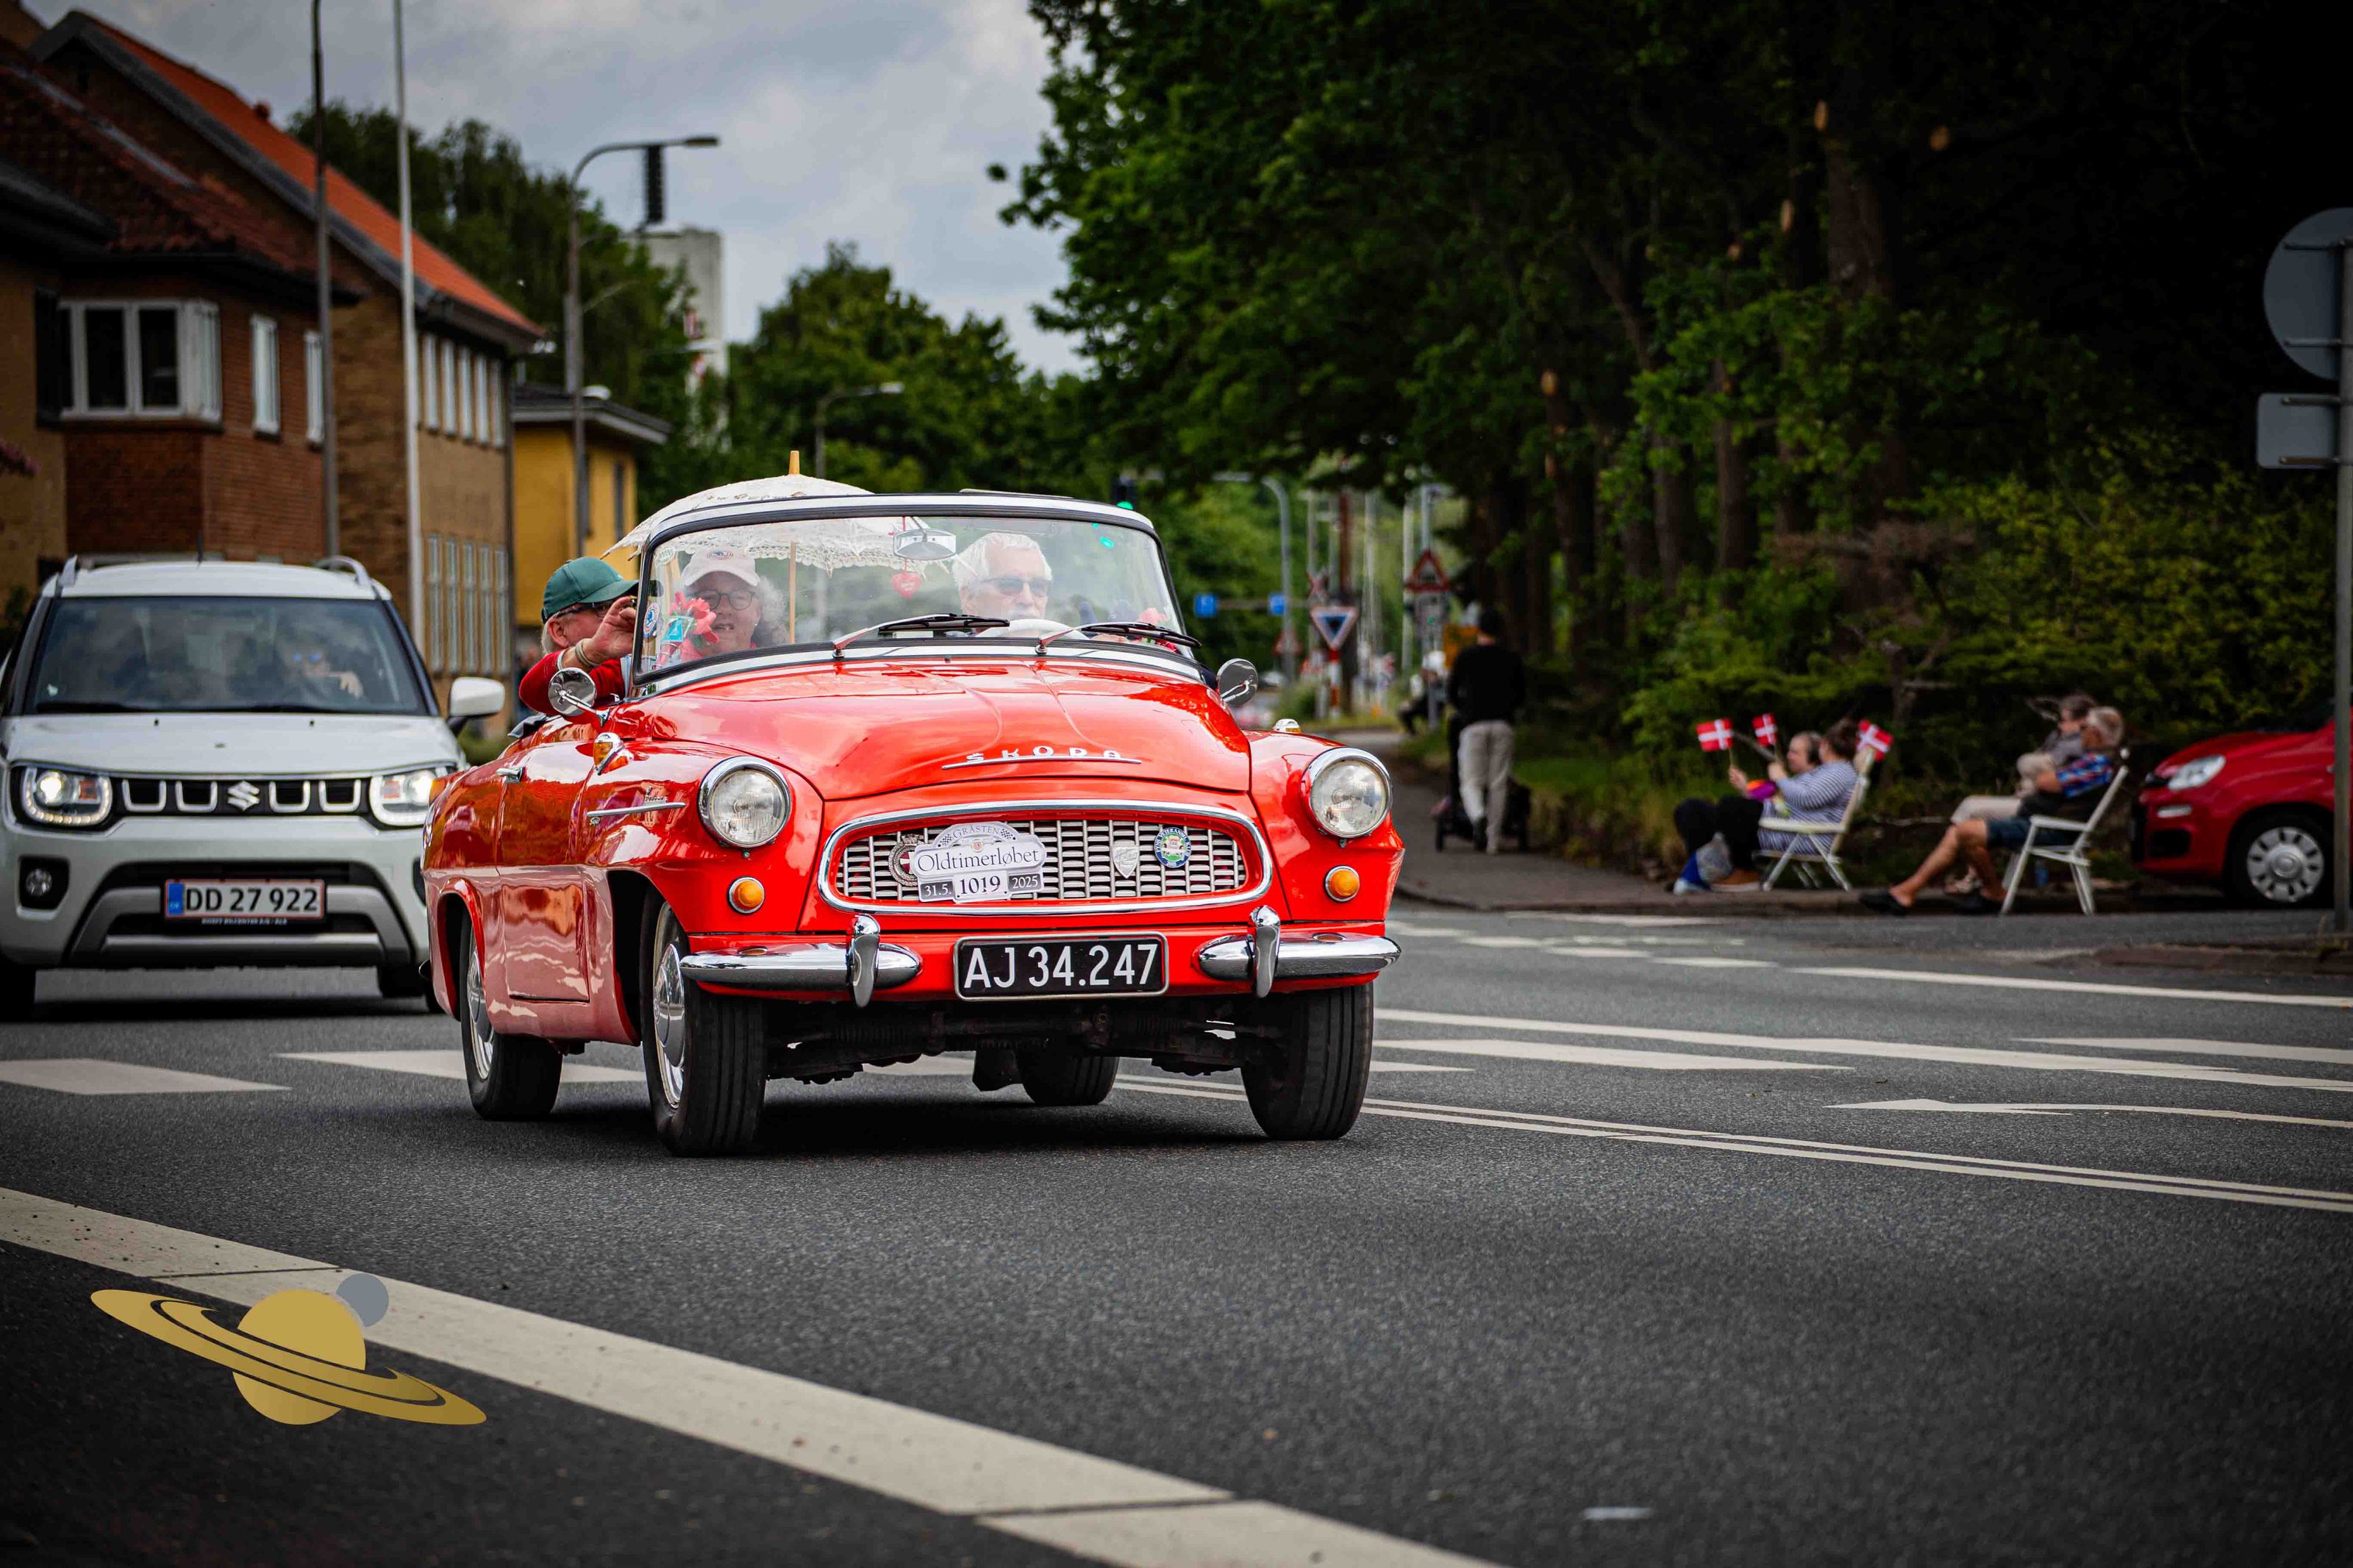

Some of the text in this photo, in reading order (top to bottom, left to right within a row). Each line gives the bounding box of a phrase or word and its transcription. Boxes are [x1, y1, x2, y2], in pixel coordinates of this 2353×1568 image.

[952, 825, 1000, 839] GRÅSTEN
[918, 846, 1039, 872] Oldtimerløbet
[924, 876, 1038, 897] 31.5. 1019 2025
[186, 888, 222, 912] DD
[229, 888, 262, 912] 27
[269, 888, 318, 912] 922
[963, 944, 1158, 989] AJ 34.247
